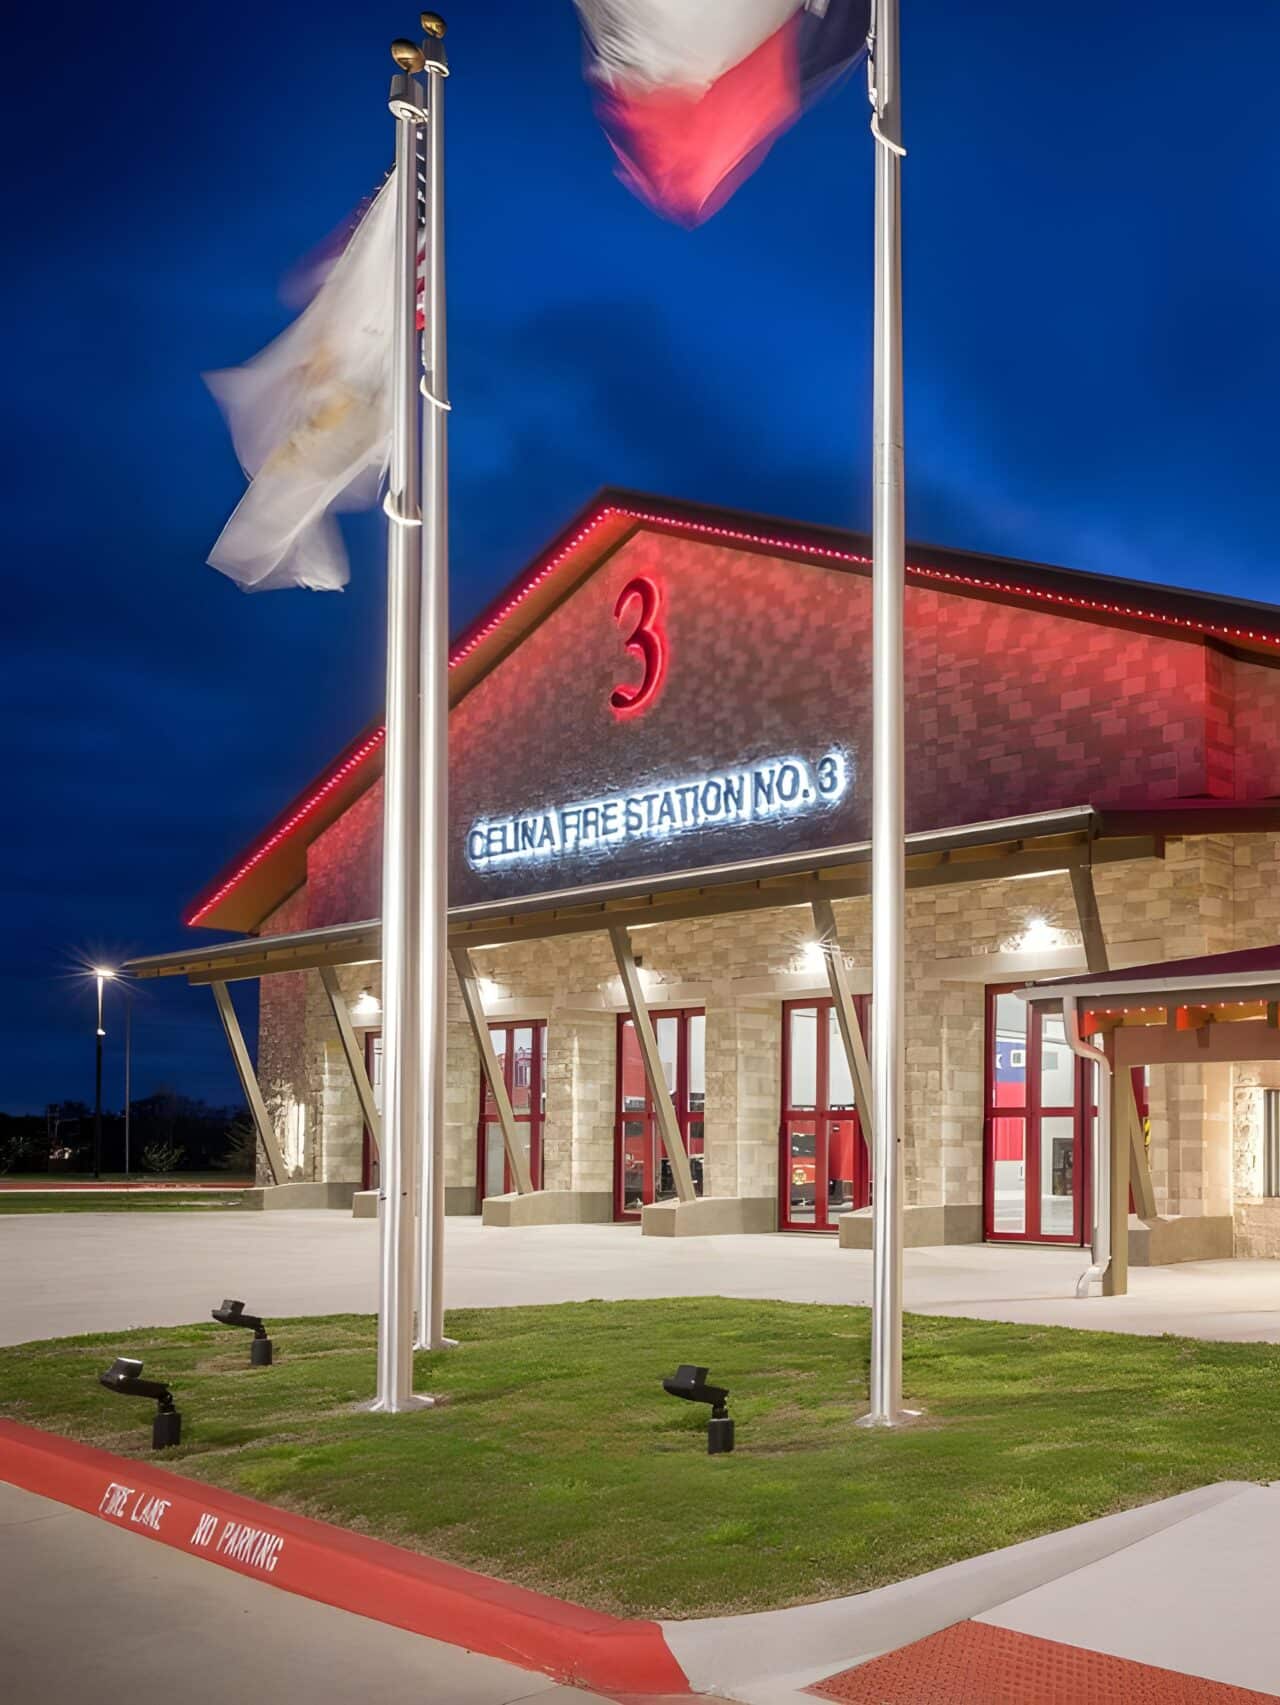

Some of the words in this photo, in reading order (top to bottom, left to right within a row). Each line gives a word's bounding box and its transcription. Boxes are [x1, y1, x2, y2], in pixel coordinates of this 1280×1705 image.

[610, 577, 662, 711] 3
[469, 816, 556, 861] CELINA
[561, 803, 619, 843] FIRE
[625, 775, 745, 832] STATION
[754, 764, 810, 808] NO.
[818, 756, 839, 794] 3
[98, 1482, 136, 1518] FIRE
[131, 1492, 172, 1530] LANE
[191, 1512, 219, 1547] NO
[216, 1521, 285, 1572] PARKING
